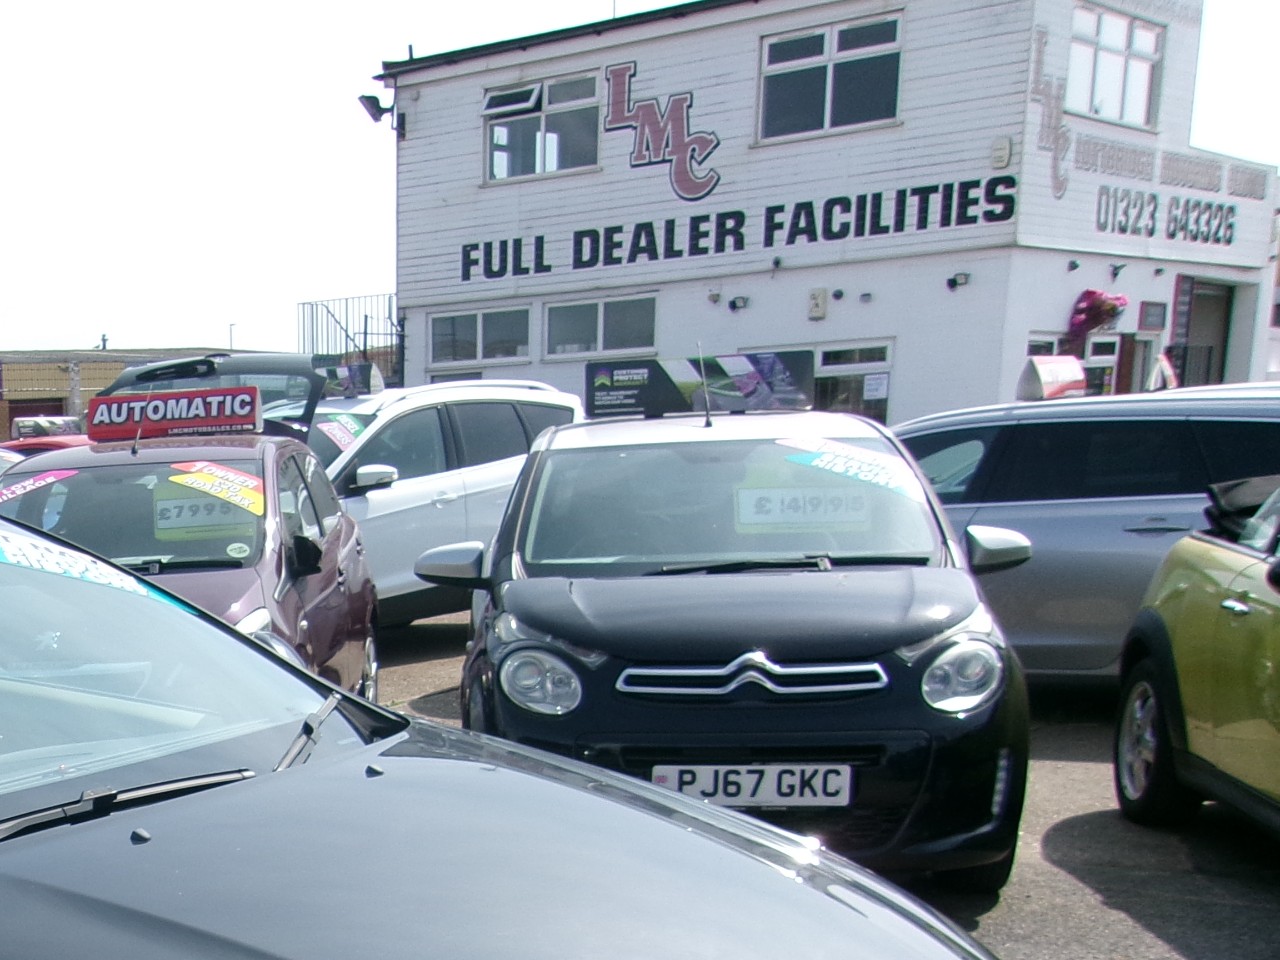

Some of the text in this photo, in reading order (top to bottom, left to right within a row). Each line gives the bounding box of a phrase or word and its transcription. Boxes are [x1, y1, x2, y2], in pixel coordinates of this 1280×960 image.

[605, 61, 720, 201] LMC
[461, 174, 1018, 282] FULL DEALER FACILITIES
[1095, 185, 1237, 246] 01323 643326
[92, 394, 252, 425] AUTOMATIC
[2, 478, 34, 494] LOW
[184, 477, 256, 509] ROAD TAX
[203, 467, 258, 488] OWNER
[158, 502, 233, 521] £7995
[677, 768, 842, 798] PJ67 GKC
